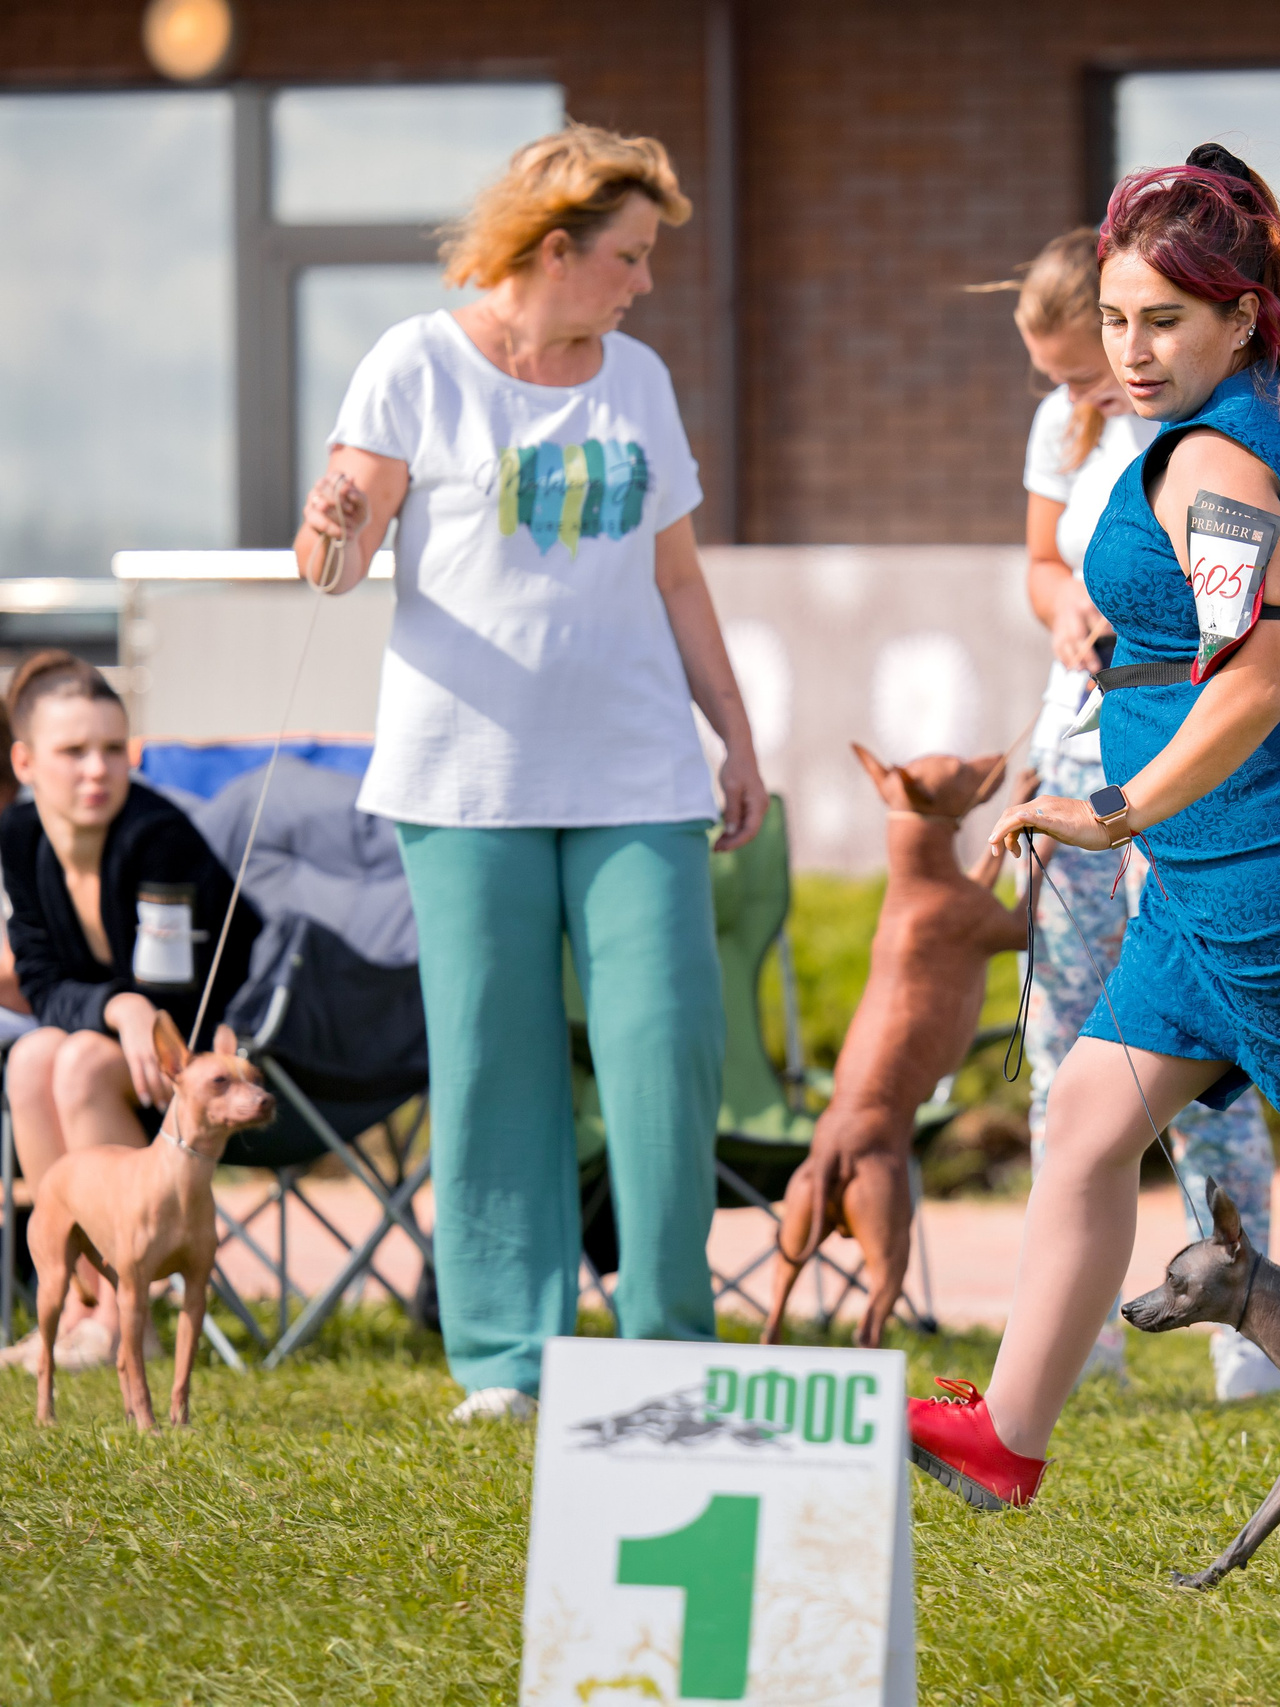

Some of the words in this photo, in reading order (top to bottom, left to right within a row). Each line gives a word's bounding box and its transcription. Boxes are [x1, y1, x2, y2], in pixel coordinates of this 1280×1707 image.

[1190, 516, 1249, 539] PREMIER
[1192, 557, 1258, 598] 605
[704, 1367, 878, 1446] РФОС
[615, 1493, 761, 1701] 1
